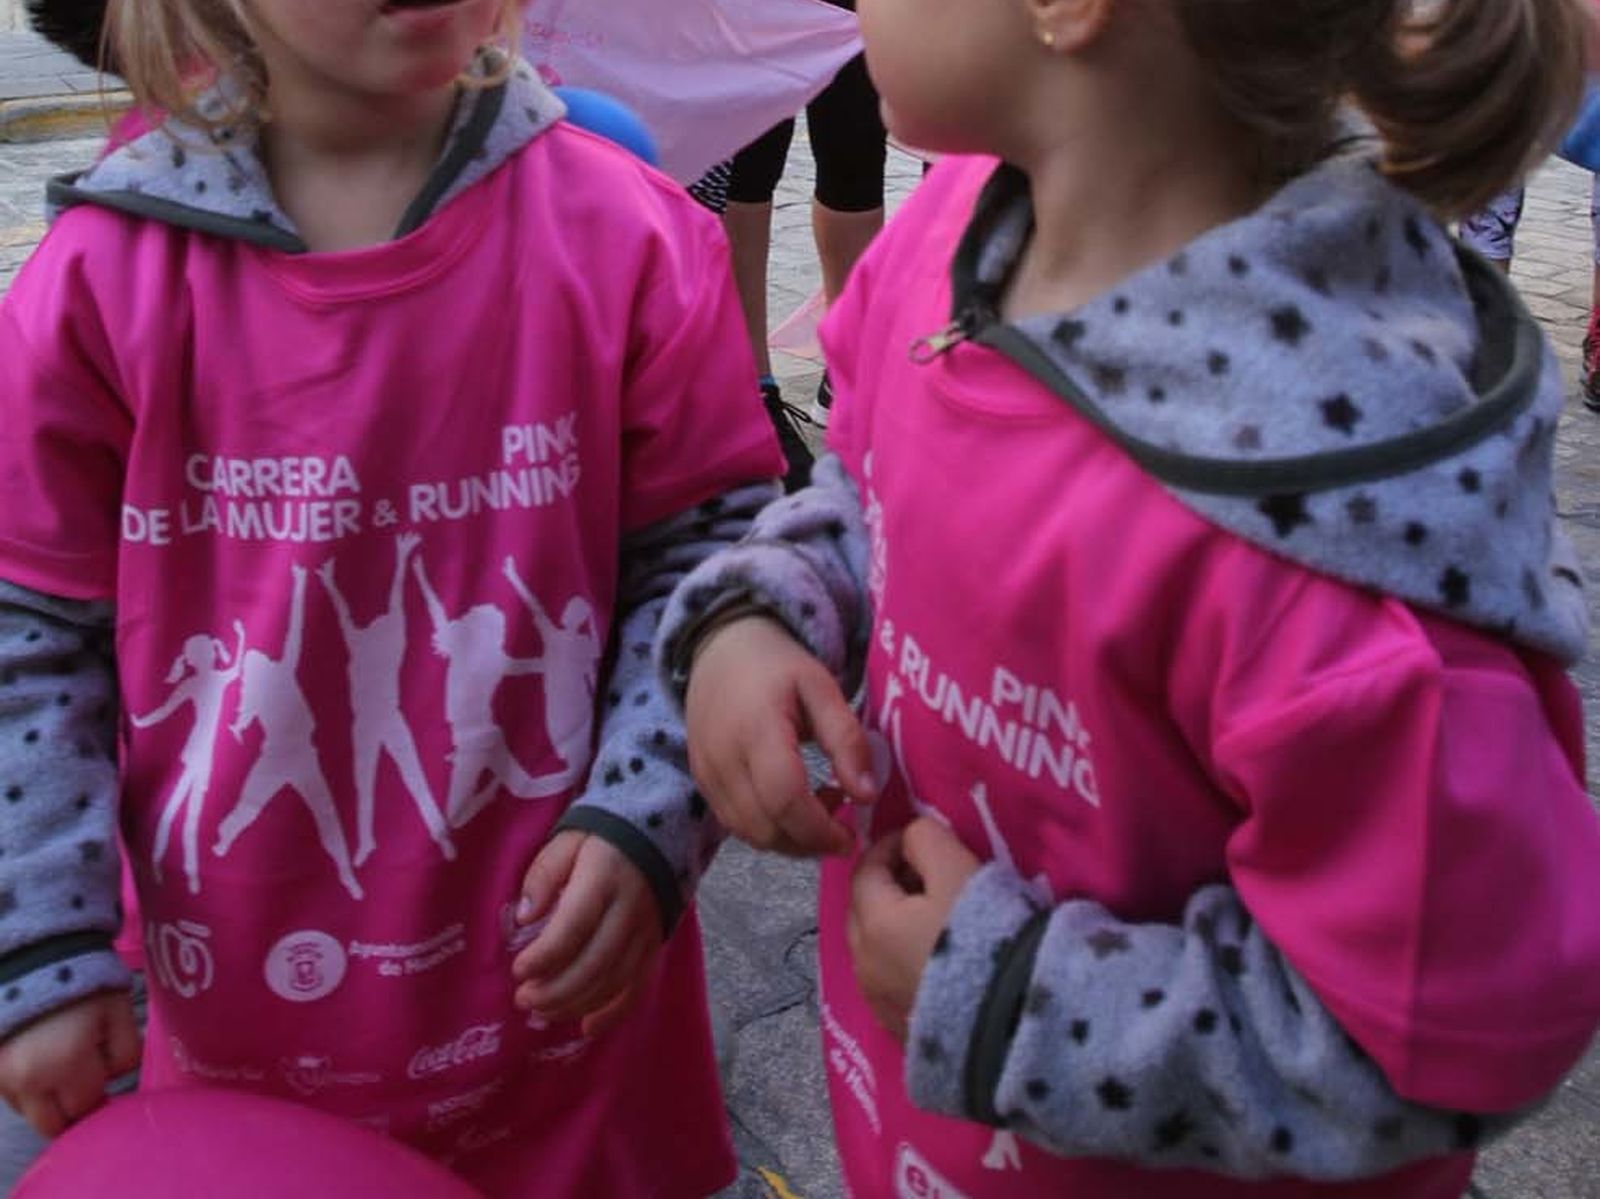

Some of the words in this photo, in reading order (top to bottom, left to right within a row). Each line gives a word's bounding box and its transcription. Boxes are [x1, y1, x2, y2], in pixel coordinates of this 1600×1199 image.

[502, 412, 577, 465] PINK
[121, 503, 171, 546] DE
[181, 495, 222, 536] LA
[226, 498, 361, 542] MUJER
[372, 498, 398, 528] &
[409, 453, 581, 523] RUNNING
[186, 453, 361, 498] CARRERA
